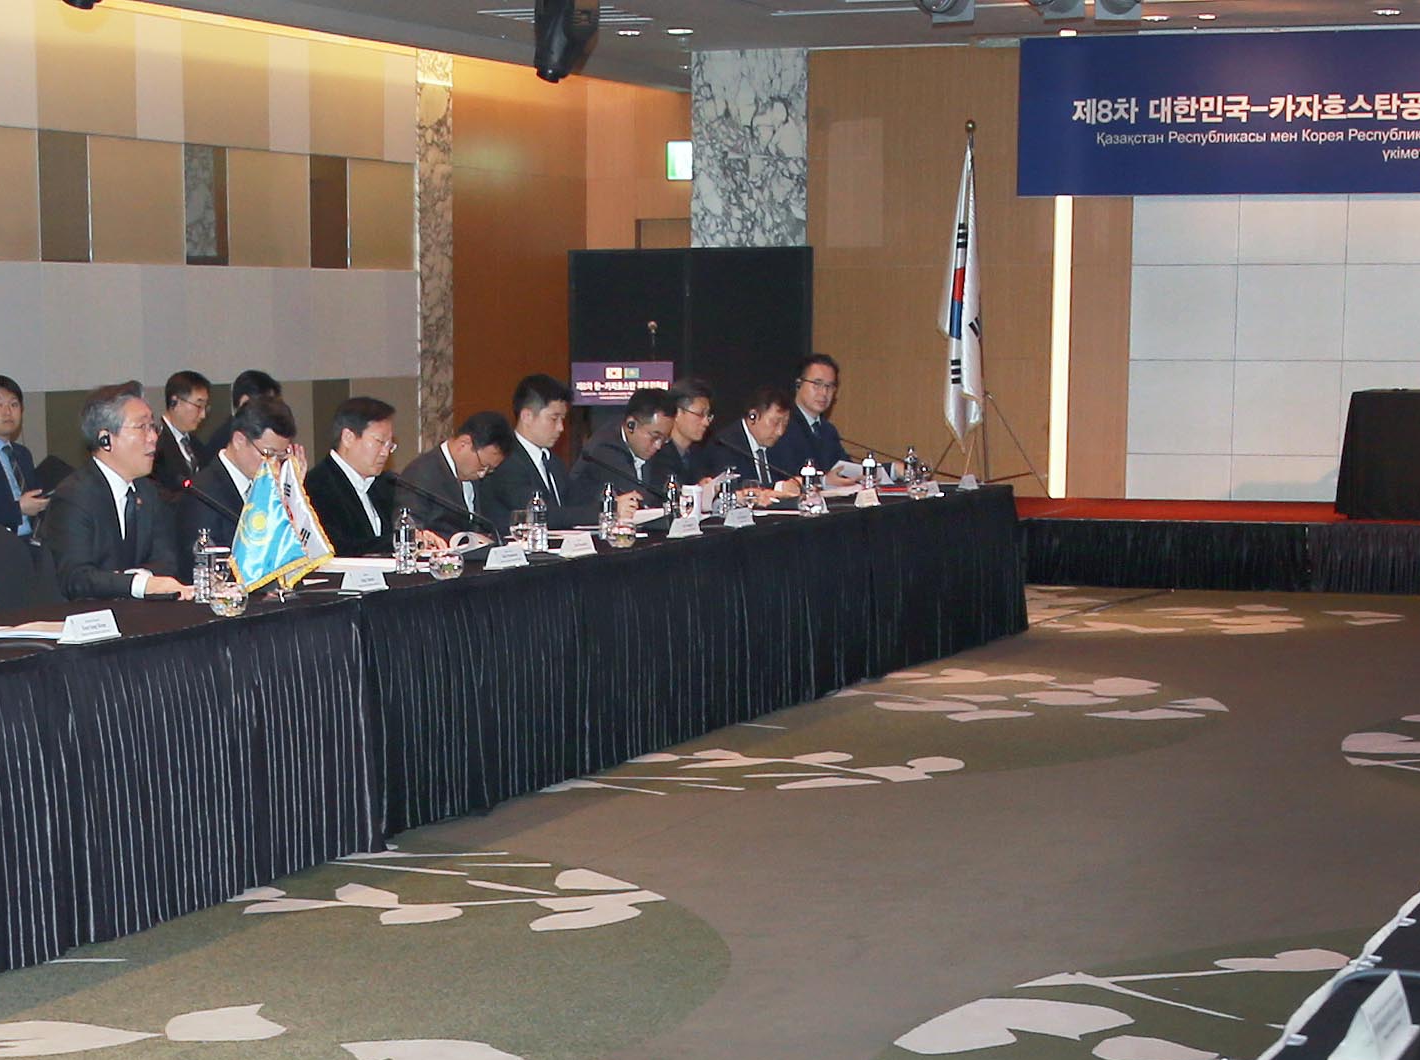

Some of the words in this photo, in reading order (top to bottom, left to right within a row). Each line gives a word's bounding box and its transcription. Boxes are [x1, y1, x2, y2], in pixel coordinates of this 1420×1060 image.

[1072, 97, 1138, 125] 제8차
[1096, 132, 1164, 146] Қазақстан
[1168, 130, 1266, 147] Республикасы
[1271, 132, 1297, 143] мен
[1301, 129, 1344, 145] Корея
